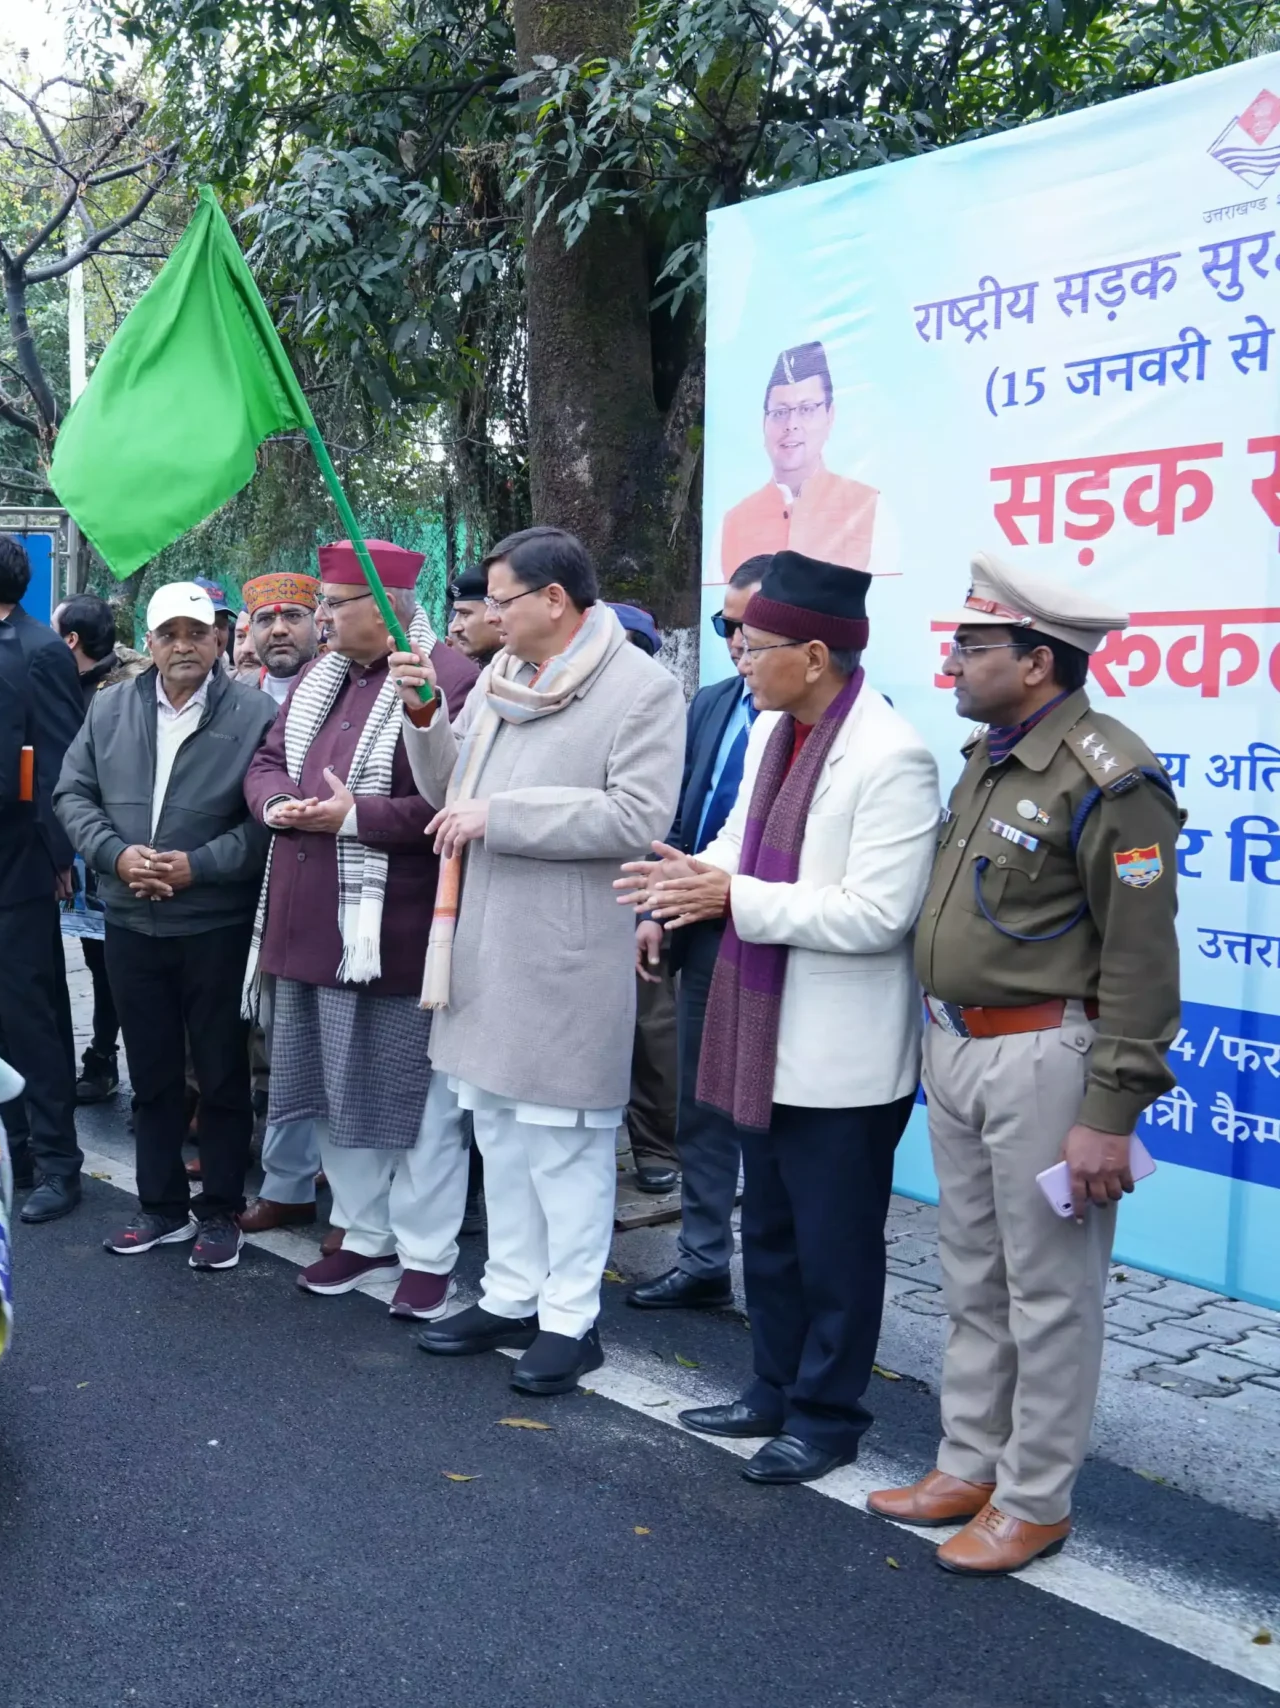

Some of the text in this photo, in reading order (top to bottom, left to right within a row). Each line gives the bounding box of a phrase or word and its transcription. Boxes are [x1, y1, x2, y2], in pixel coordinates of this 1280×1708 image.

[1203, 197, 1268, 223] उत्तराखण्ड
[914, 230, 1280, 344] राष्ट्रीय सड़क सुर
[985, 314, 1276, 417] (15 जनवरी से
[990, 441, 1223, 566] सड़क
